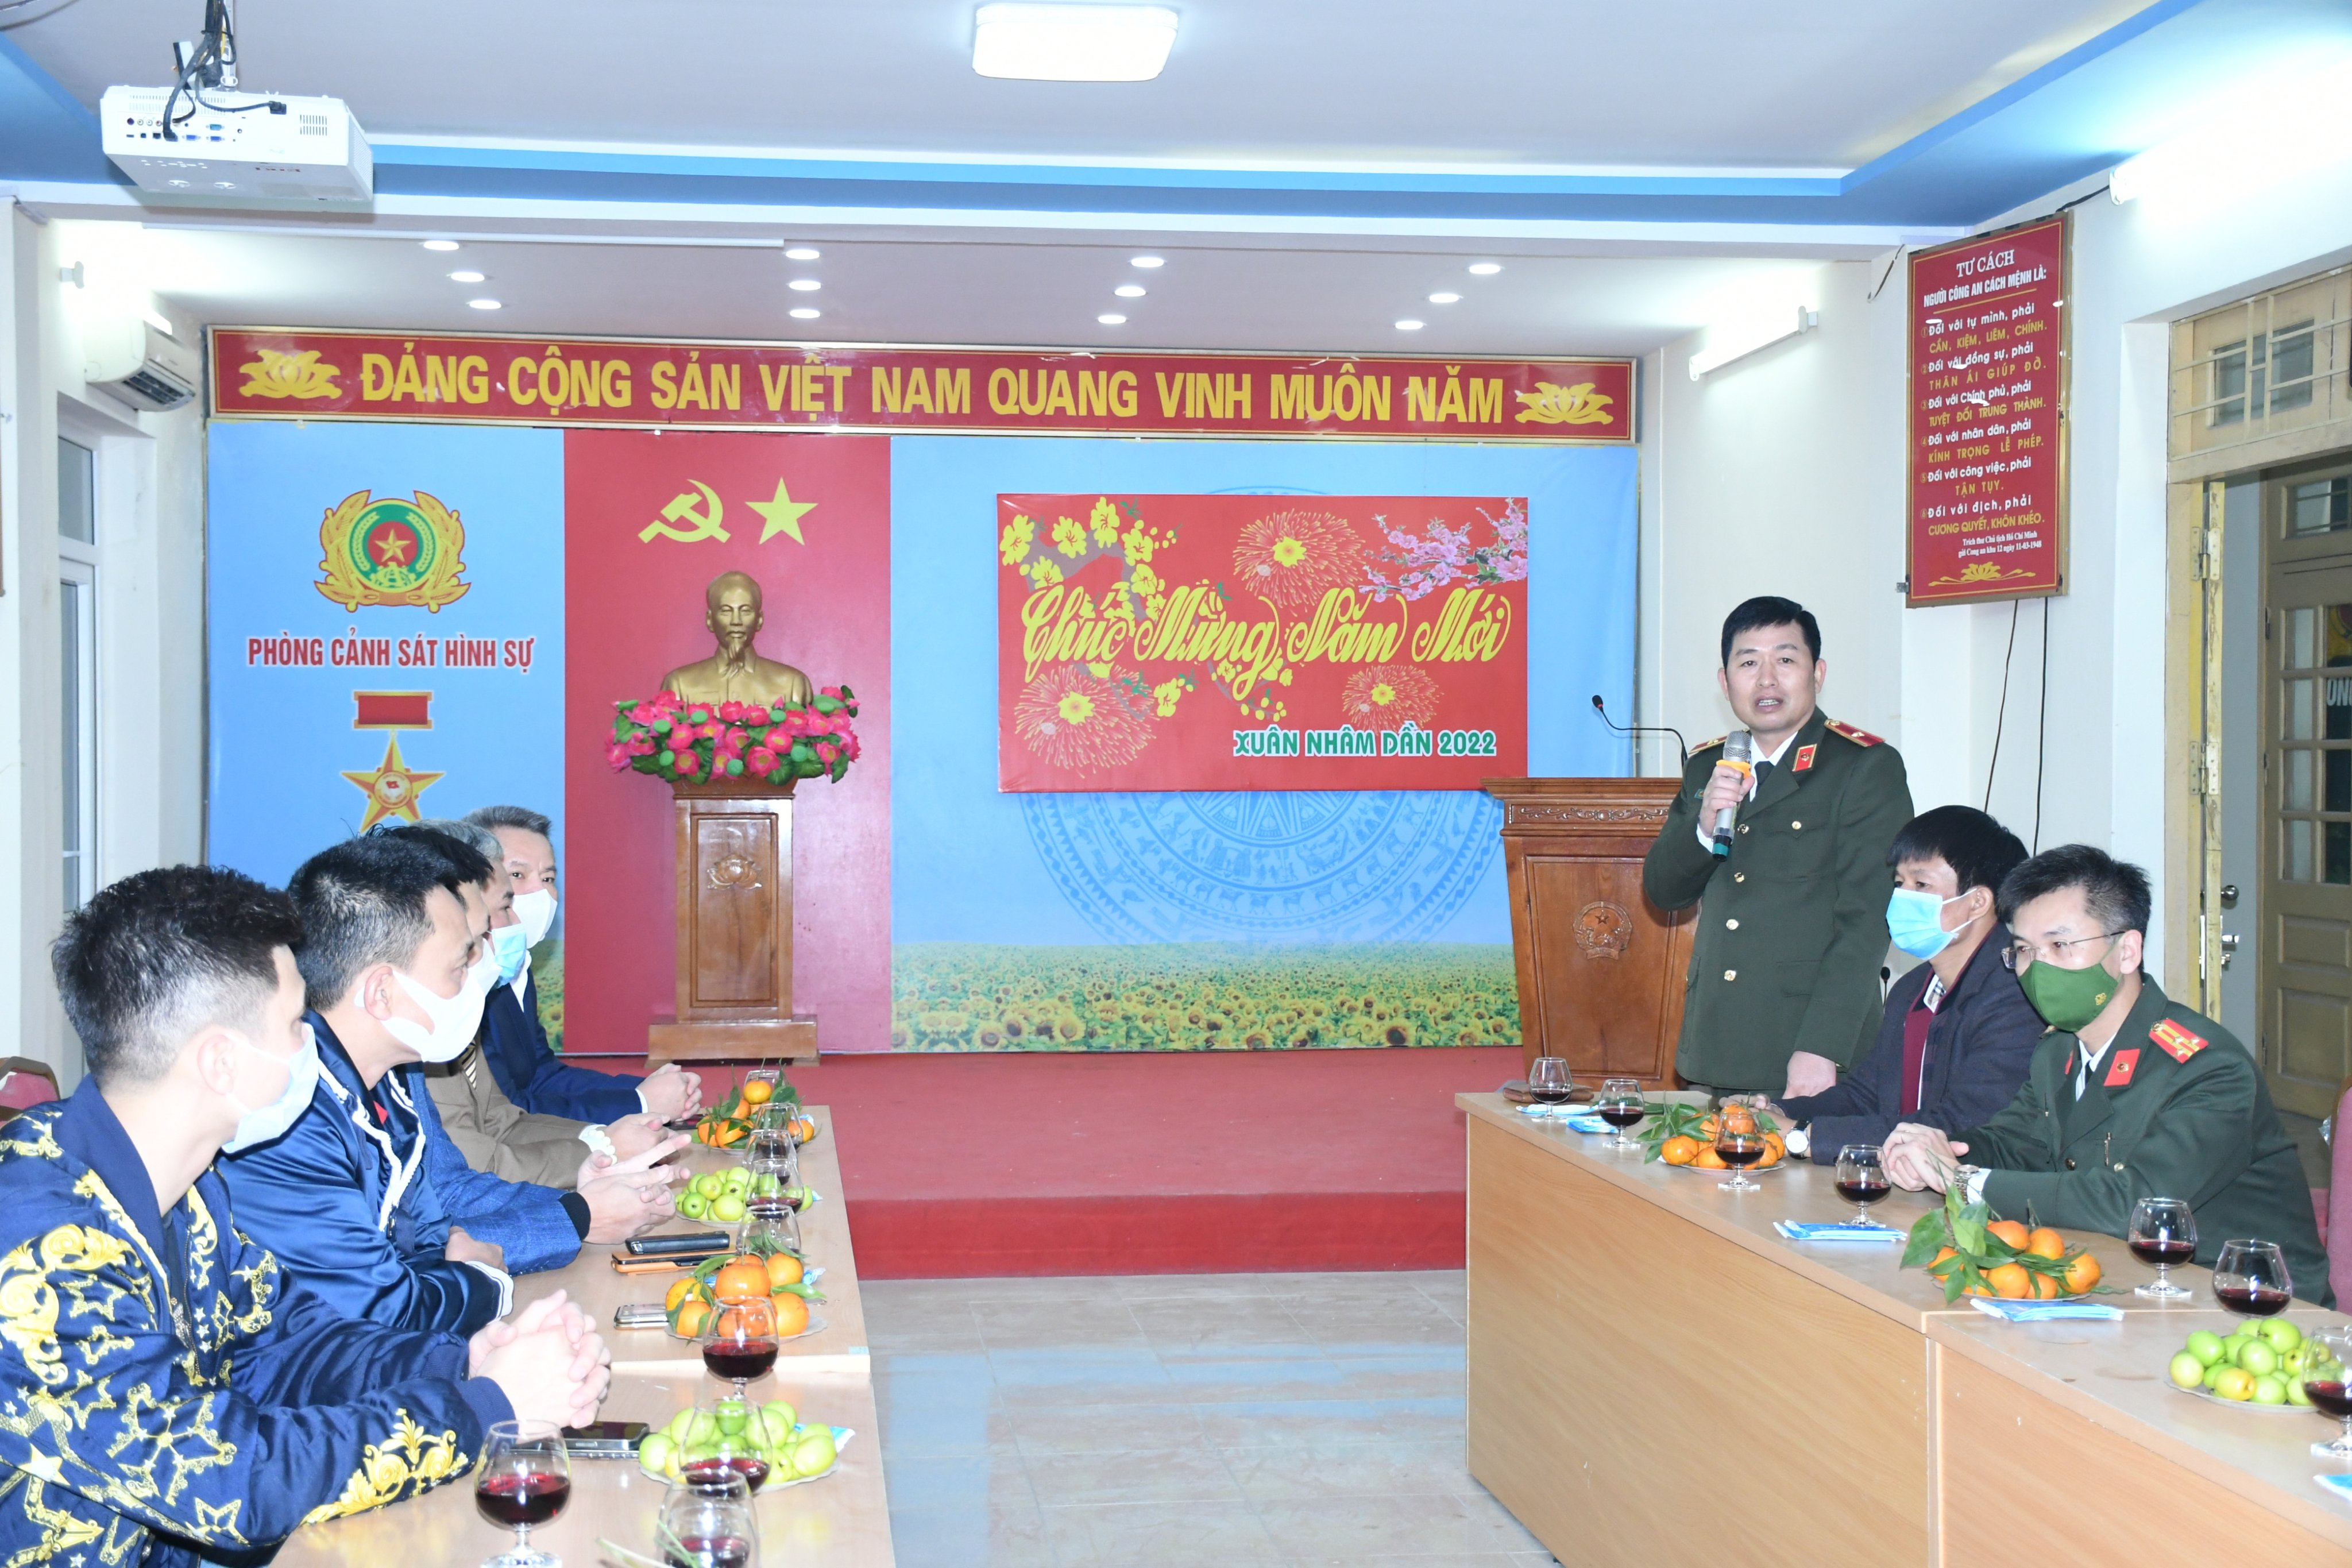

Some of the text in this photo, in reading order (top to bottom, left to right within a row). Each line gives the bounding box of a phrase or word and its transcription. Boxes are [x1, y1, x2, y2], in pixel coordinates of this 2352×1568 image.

[1956, 249, 2015, 277] TƯ CÁCH
[1924, 264, 2046, 307] NGƯỜI CÔNG AN CÁCH MỆNH LÀ:
[1949, 317, 1963, 331] với
[1967, 317, 1976, 329] tự
[1981, 310, 2007, 325] mình,
[2012, 302, 2034, 320] phải
[1957, 334, 1981, 349] KIỆM,
[1986, 328, 2009, 342] LIÊM,
[2015, 319, 2046, 336] CHÍNH.
[1928, 358, 1943, 372] Đối
[1965, 351, 1990, 365] đồng
[1994, 349, 2008, 361] sự,
[2011, 341, 2033, 358] phải
[360, 342, 1503, 424] ĐẢNG CỘNG SẢN VIỆT NAM QUANG VINH MUÔN NĂM
[1929, 375, 1957, 391] THÂN
[1967, 369, 1978, 384] ÁI
[1987, 362, 2015, 379] GIÚP
[1928, 395, 1942, 409] Đối
[1945, 393, 1958, 405] với
[1988, 384, 2009, 400] phủ,
[2011, 379, 2031, 396] phải
[1929, 412, 1951, 427] TUYỆT
[1956, 406, 1972, 422] ĐỐI
[1979, 404, 2007, 418] TRUNG
[1928, 432, 1942, 446] Đối
[1945, 431, 1959, 443] với
[1961, 427, 1984, 441] nhân
[1987, 424, 2009, 436] dân,
[2011, 417, 2031, 434] phải
[1929, 433, 2044, 463] KÍNH TRỌNG LỄ PHÉP.
[1928, 469, 1942, 482] Đối
[1944, 468, 1958, 480] với
[1960, 465, 1983, 477] công
[1986, 461, 2009, 475] việc,
[2010, 455, 2031, 472] phải
[1955, 482, 1975, 498] TẬN
[1928, 505, 1945, 518] Đối
[1951, 503, 1967, 515] với
[1972, 499, 2002, 514] địch,
[2005, 494, 2032, 510] phải
[1928, 523, 1960, 536] CƯƠNG
[1991, 514, 2016, 528] KHÔN
[1287, 587, 1408, 663] Năm
[1411, 587, 1512, 662] Mới
[248, 627, 534, 673] PHÒNG CẢNH SÁT HÌNH SỰ
[1234, 721, 1496, 755] XUÂN NHÂM DẦN 2022
